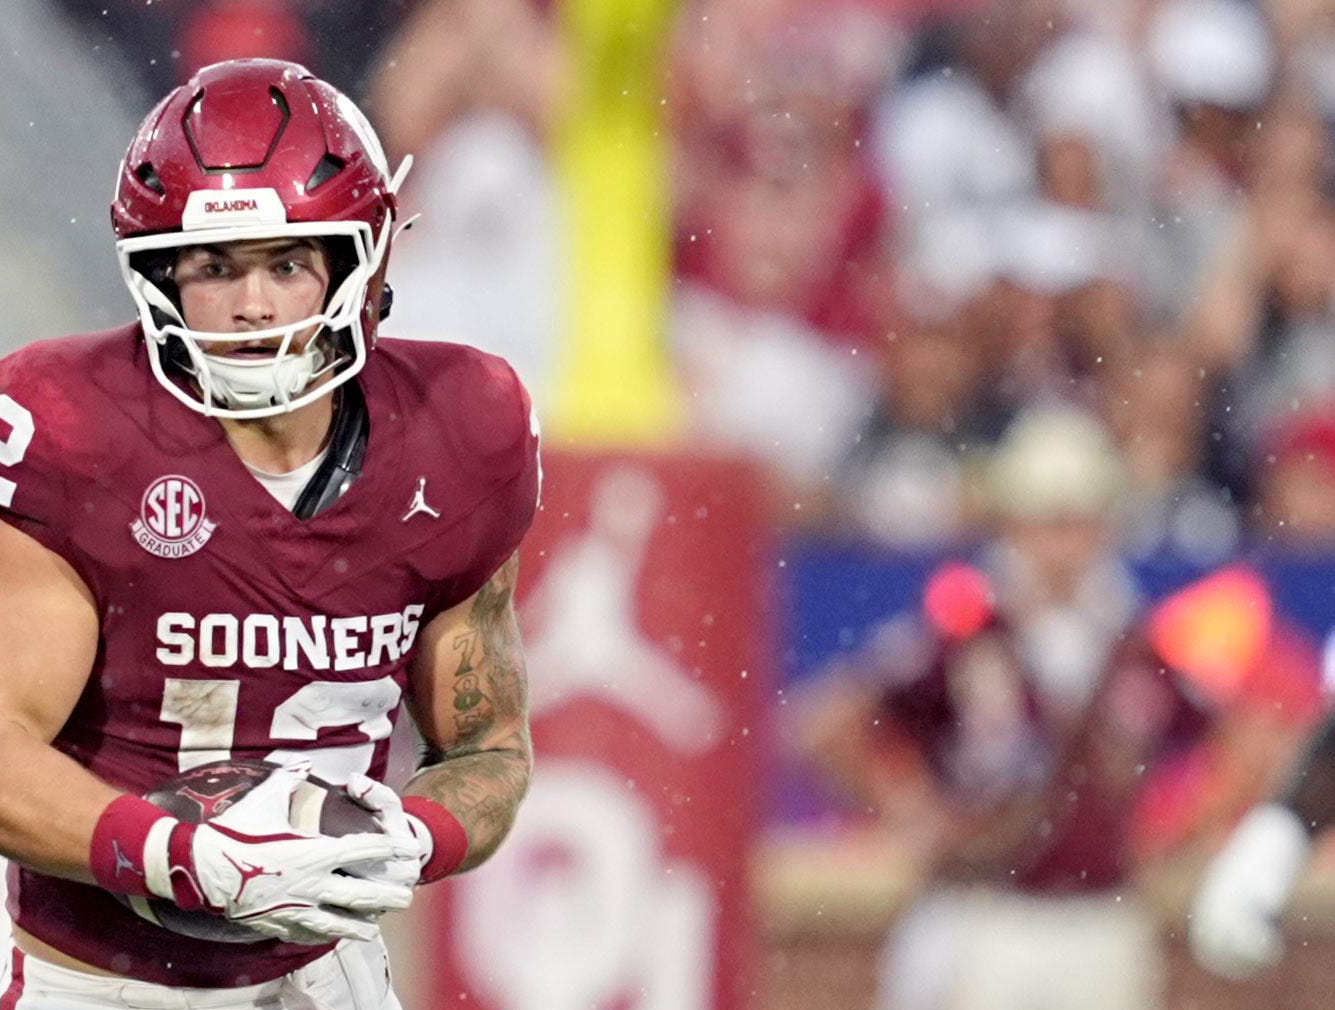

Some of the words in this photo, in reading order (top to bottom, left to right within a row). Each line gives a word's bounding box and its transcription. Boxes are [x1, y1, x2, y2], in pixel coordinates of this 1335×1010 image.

[204, 199, 258, 213] OKLAHOMA
[147, 480, 199, 536] SEC
[139, 532, 205, 557] GRADUATE
[156, 604, 425, 671] SOONERS
[159, 675, 402, 786] 12
